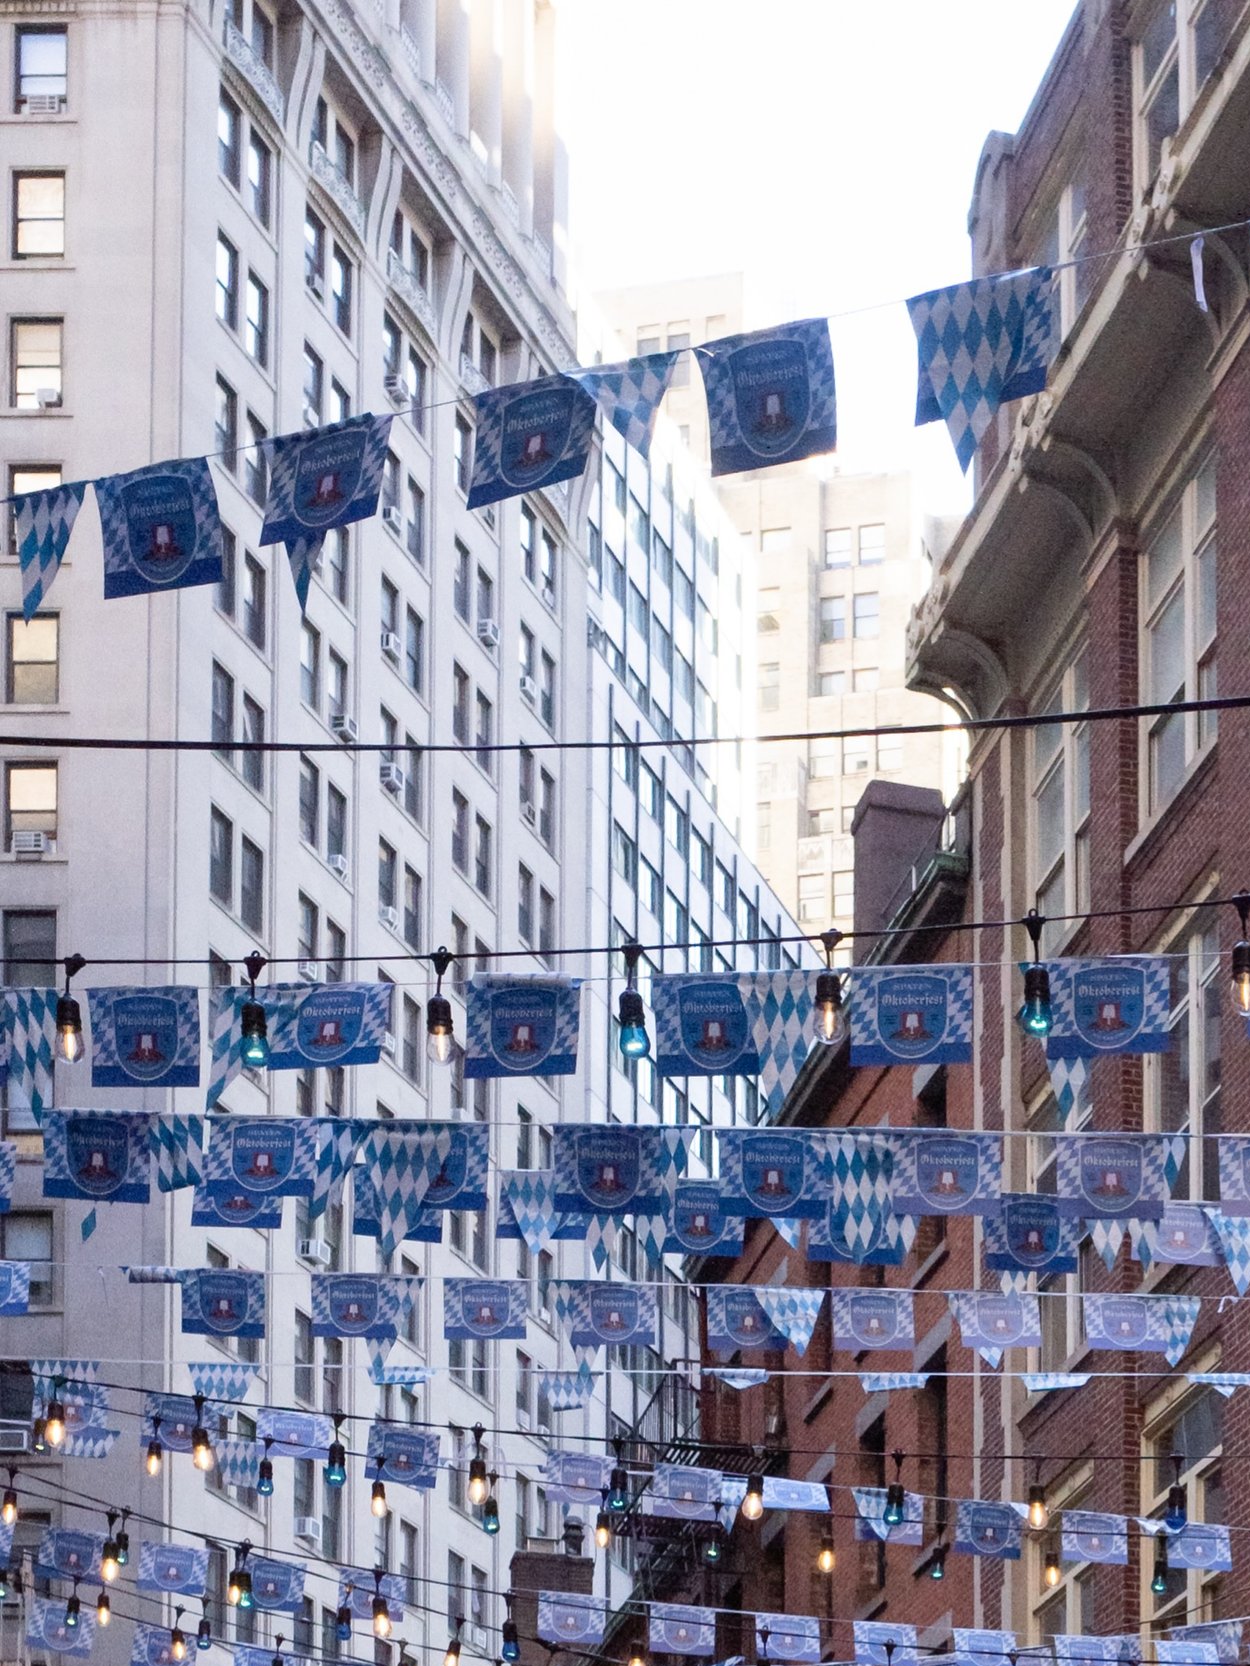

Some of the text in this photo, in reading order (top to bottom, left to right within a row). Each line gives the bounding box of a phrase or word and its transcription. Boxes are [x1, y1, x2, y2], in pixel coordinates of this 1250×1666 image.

[1078, 984, 1140, 996] Oktoberfest
[883, 994, 944, 1006] Oktoberfest
[302, 1005, 361, 1018] Oktoberfest
[236, 1136, 291, 1147] Oktoberfest
